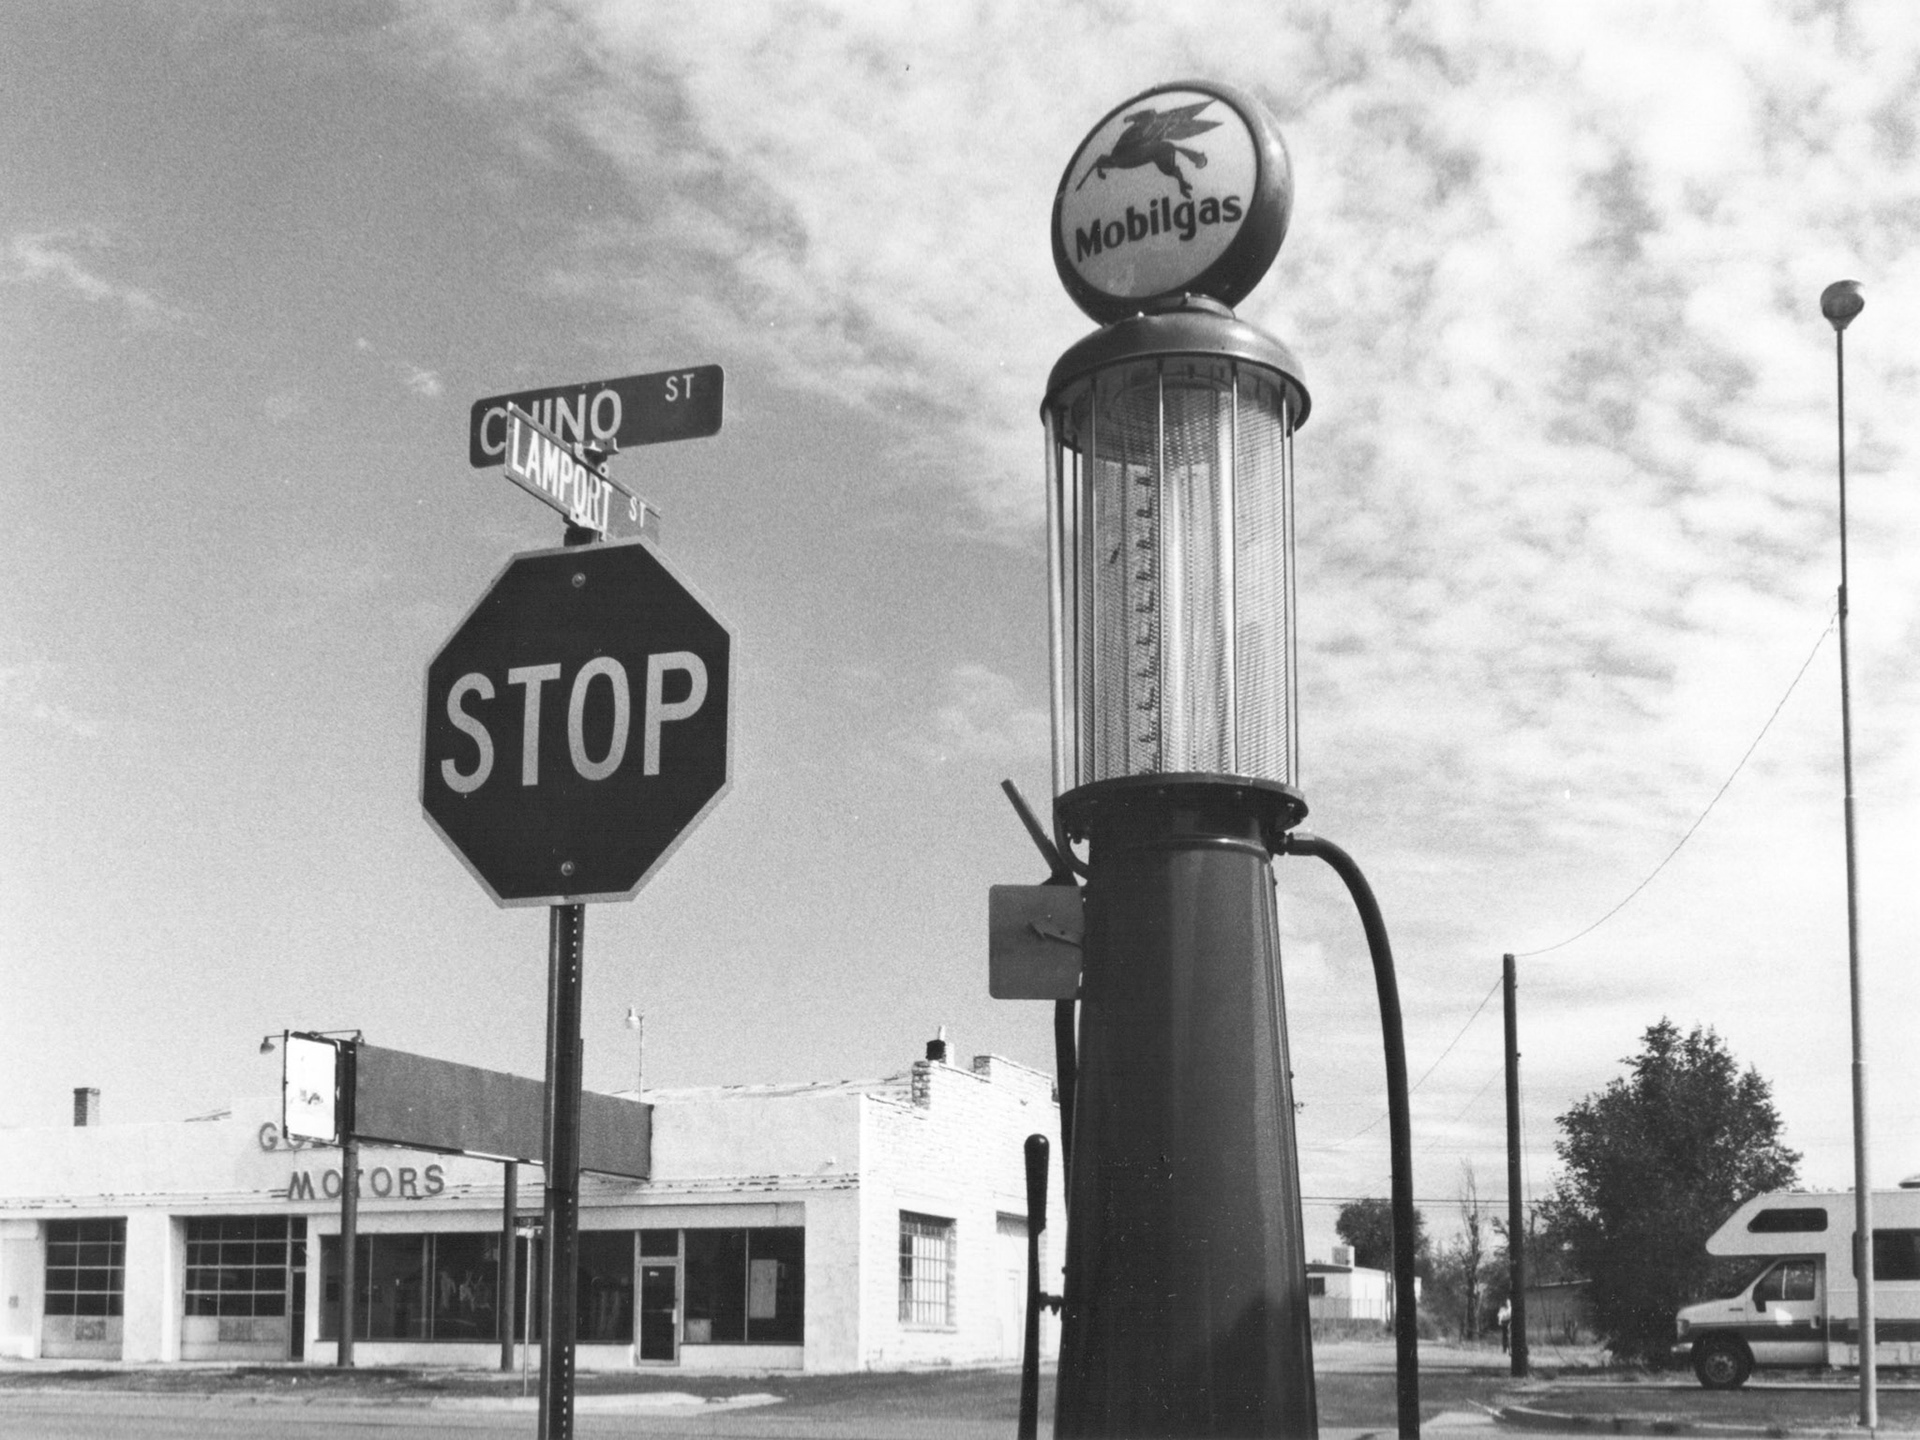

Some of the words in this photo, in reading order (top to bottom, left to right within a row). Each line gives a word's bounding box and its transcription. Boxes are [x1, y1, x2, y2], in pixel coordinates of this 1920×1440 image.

[1075, 195, 1242, 263] Mobilgas
[481, 389, 622, 455] CINO
[665, 373, 695, 402] ST
[512, 417, 613, 541] LAMPORT
[629, 496, 646, 528] ST
[441, 651, 708, 793] STOP
